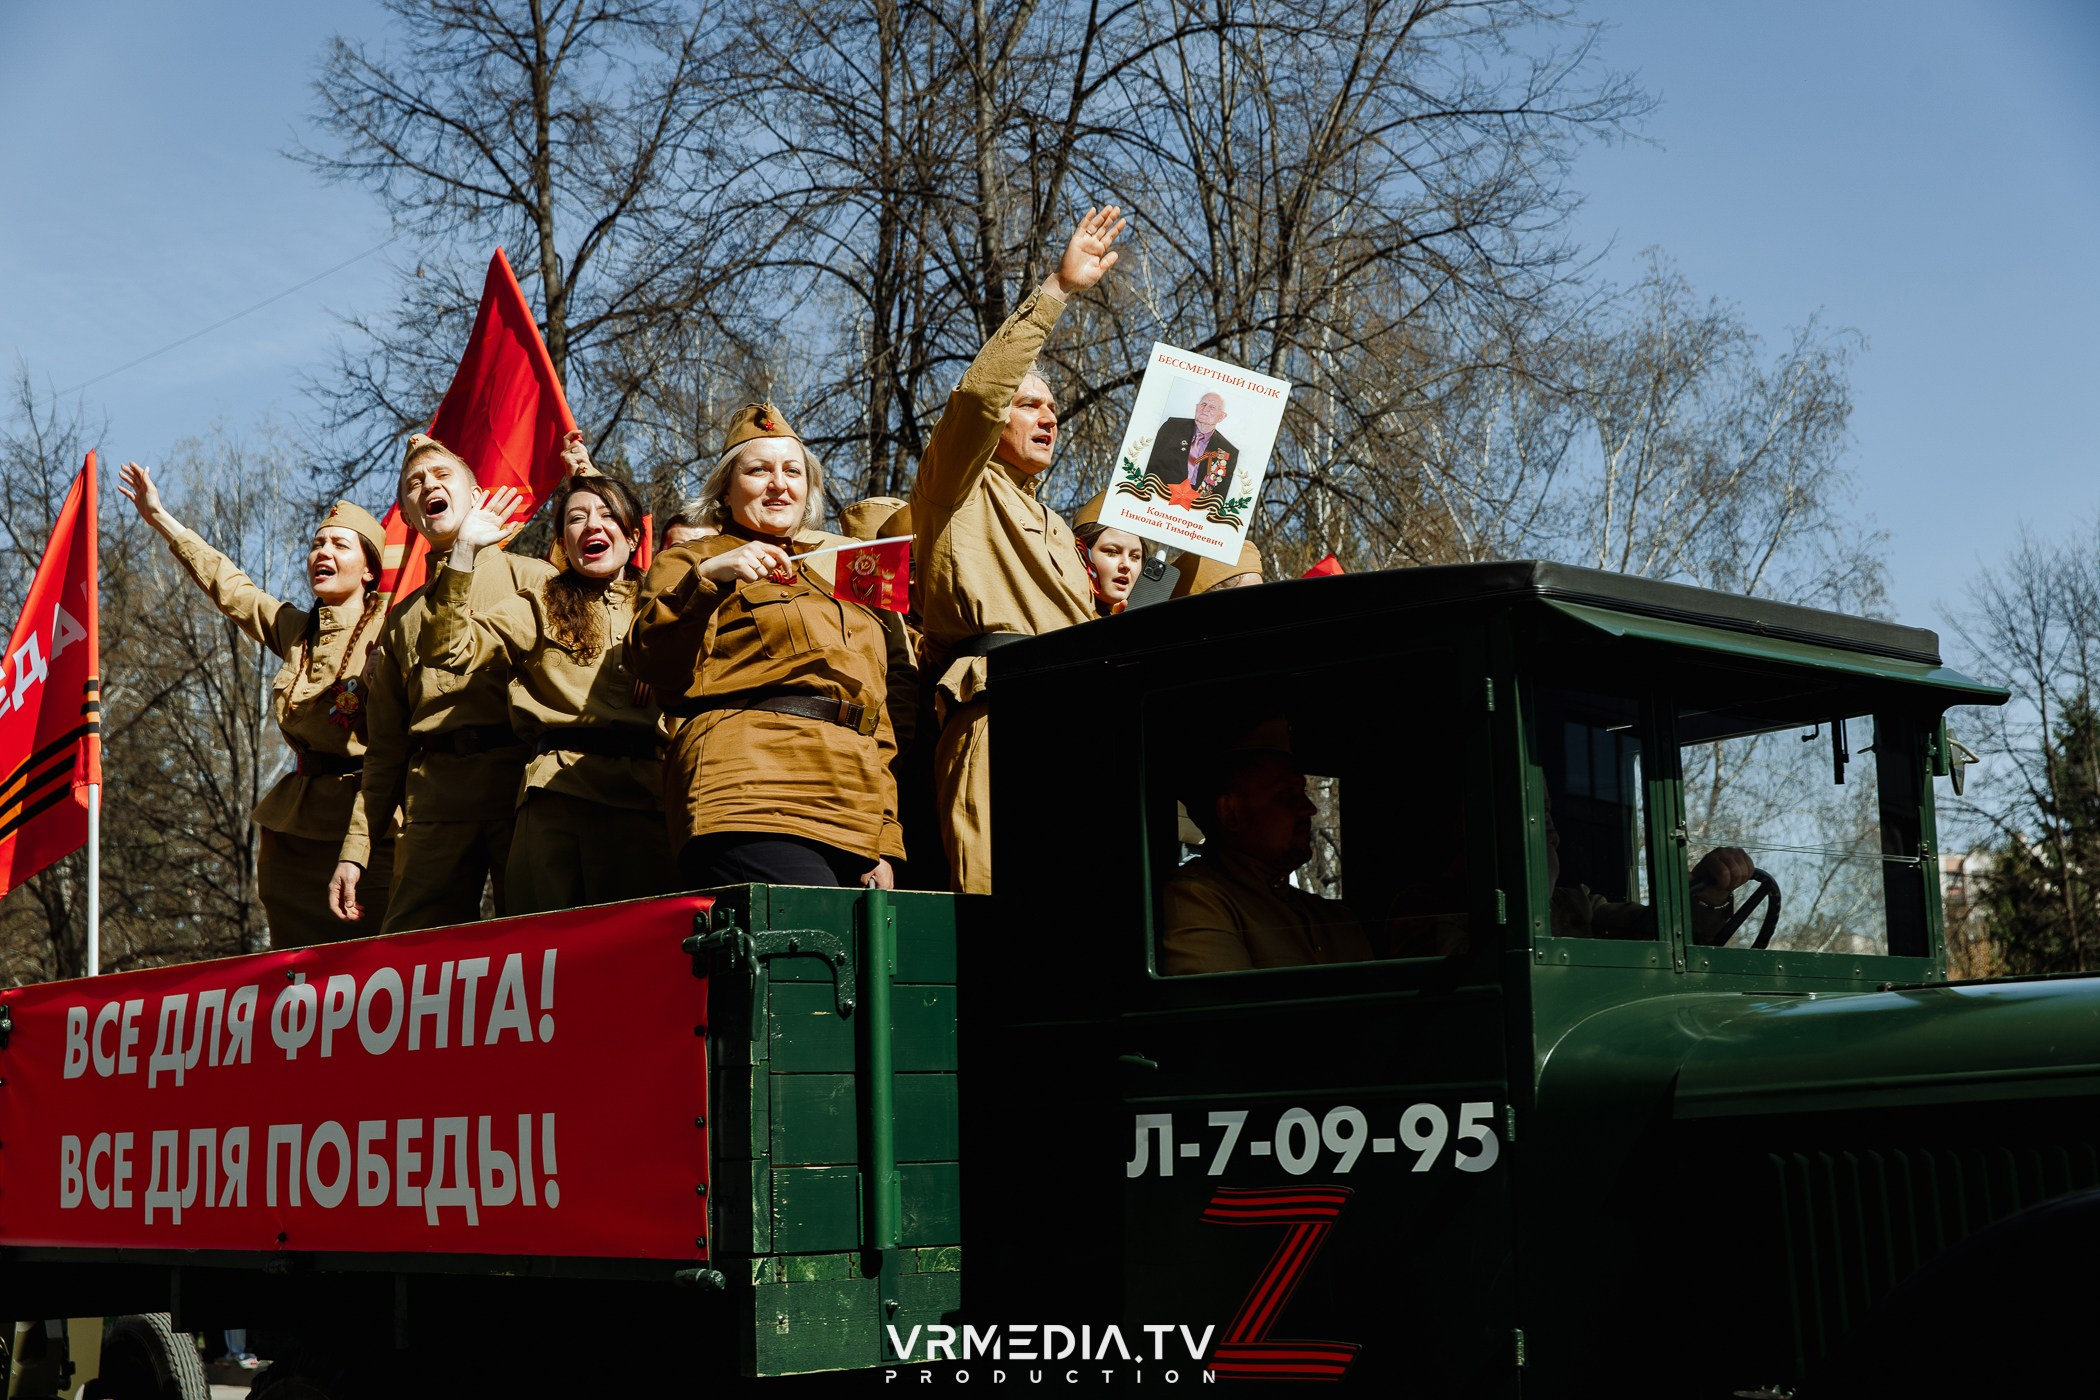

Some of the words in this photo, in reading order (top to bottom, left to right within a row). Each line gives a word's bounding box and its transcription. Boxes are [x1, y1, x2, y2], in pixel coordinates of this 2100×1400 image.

[1158, 354, 1246, 388] БЕССМЕРТНЫЙ
[1247, 382, 1281, 399] ПОЛК
[1120, 508, 1163, 528] Николай
[1165, 521, 1224, 548] Тимофеевич
[1146, 506, 1204, 531] Колмогоров
[63, 998, 144, 1080] ВСЕ
[148, 984, 259, 1089] ДЛЯ
[270, 948, 557, 1060] ФРОНТА!
[60, 1131, 134, 1210] ВСЕ
[144, 1126, 250, 1225] ДЛЯ
[266, 1112, 560, 1226] ПОБЕДЫ!
[1127, 1101, 1500, 1178] Л-7-09-95
